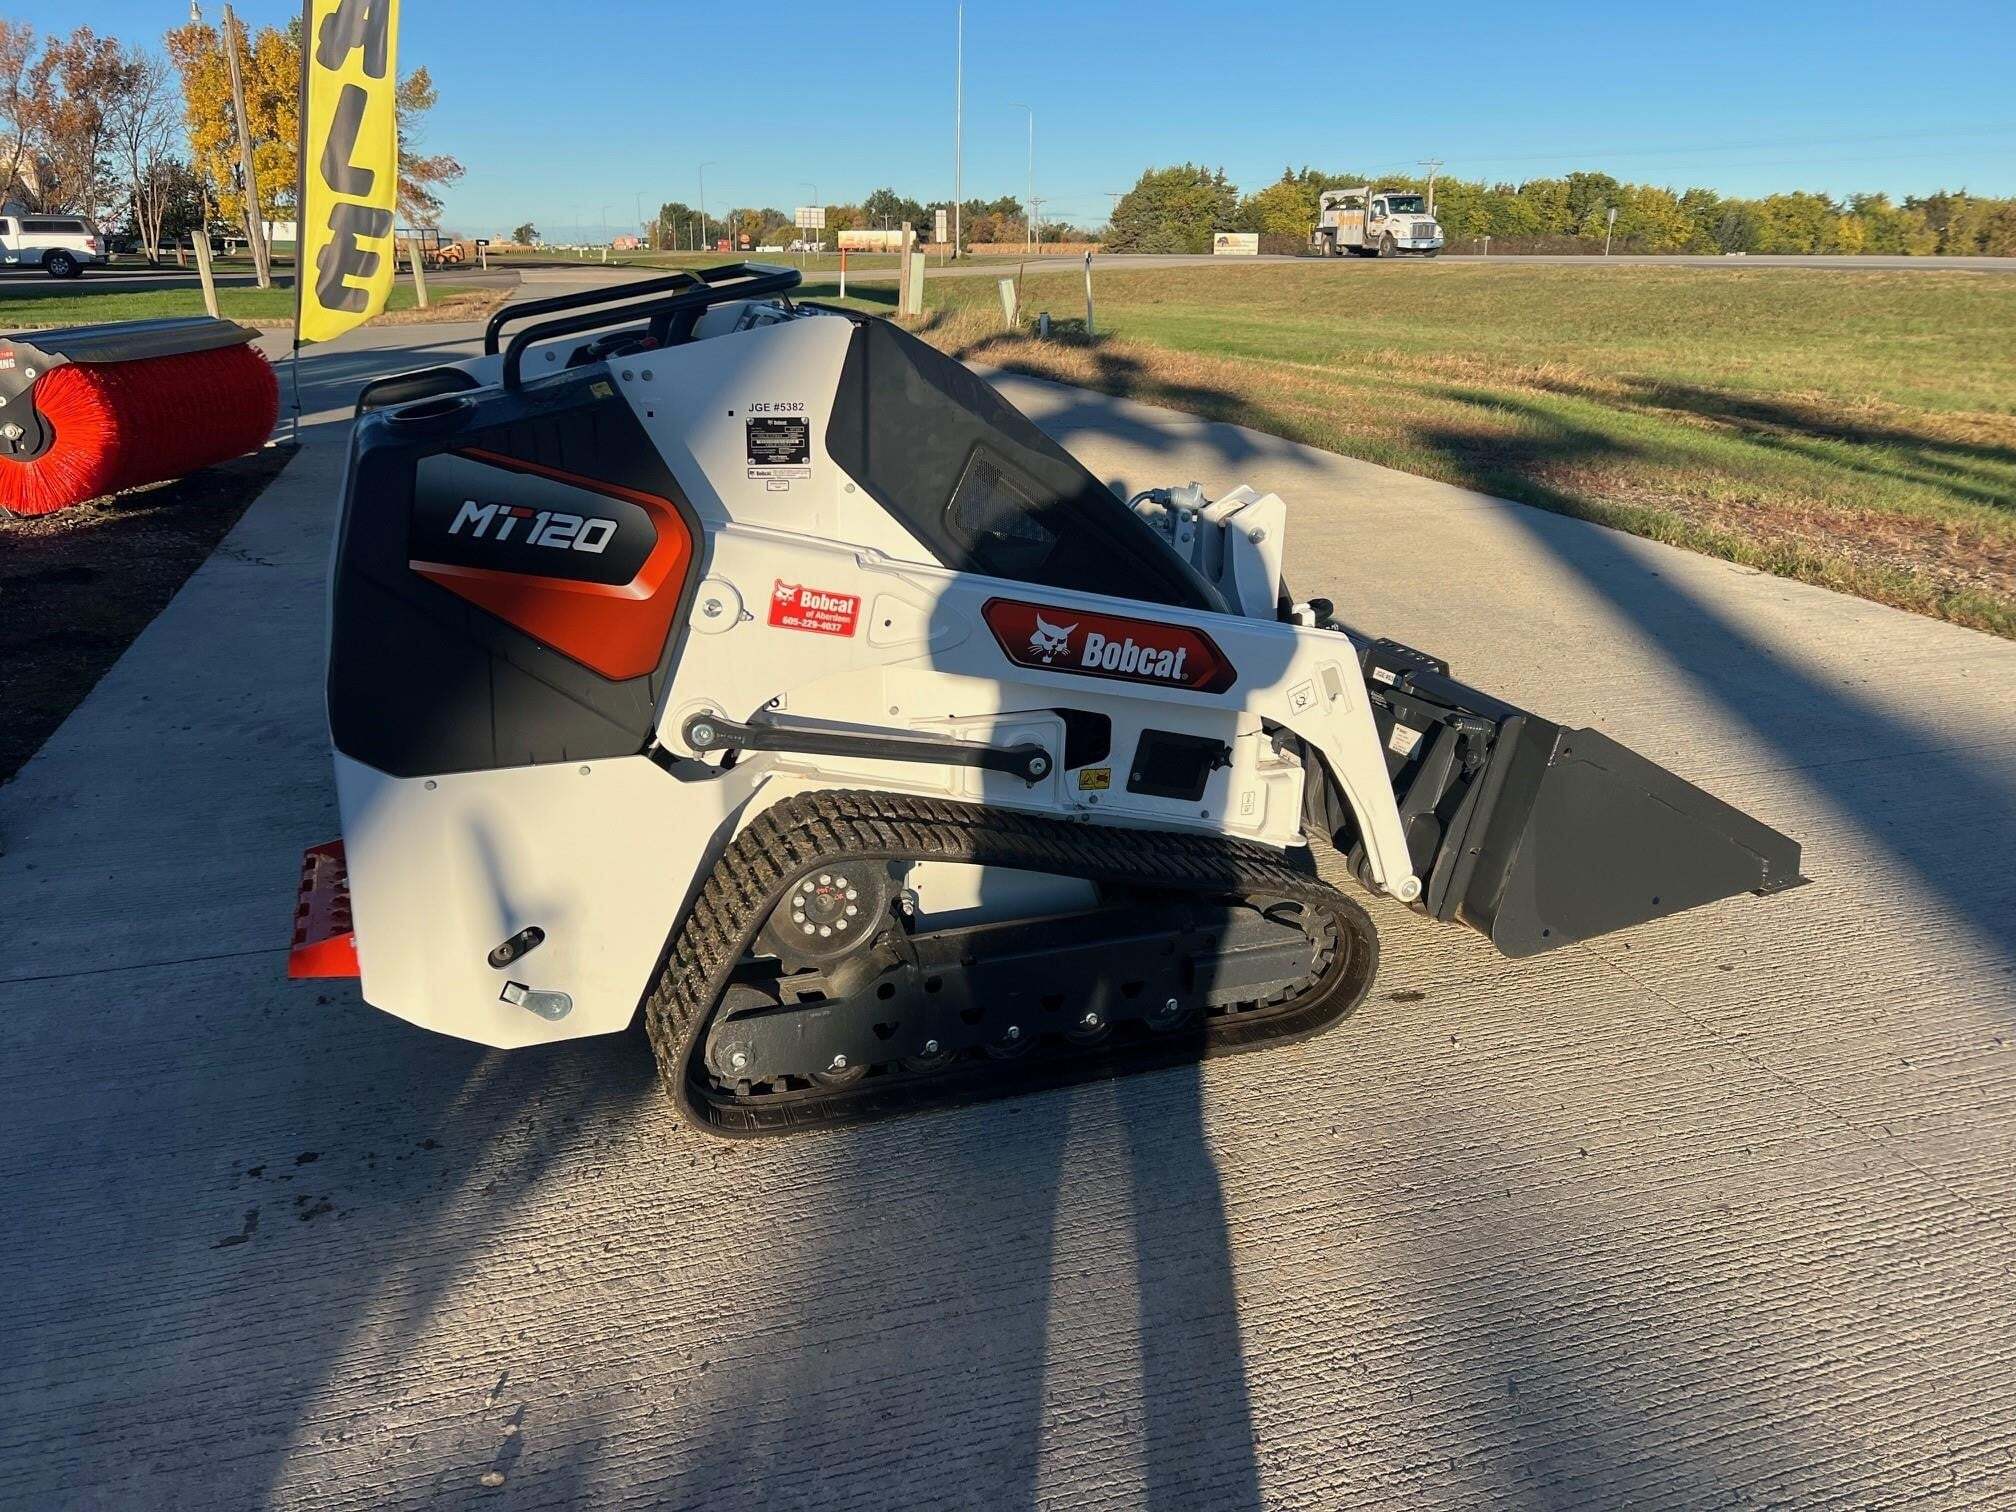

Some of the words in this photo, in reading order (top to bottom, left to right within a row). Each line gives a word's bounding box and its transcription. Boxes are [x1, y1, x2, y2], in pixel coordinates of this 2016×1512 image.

[748, 403, 771, 412] JGE
[774, 402, 804, 412] #5382
[448, 500, 618, 554] MT120
[800, 591, 854, 614] Bobcat
[805, 610, 815, 618] of
[814, 611, 851, 623] Aberdeen
[1081, 632, 1187, 680] Bobcat
